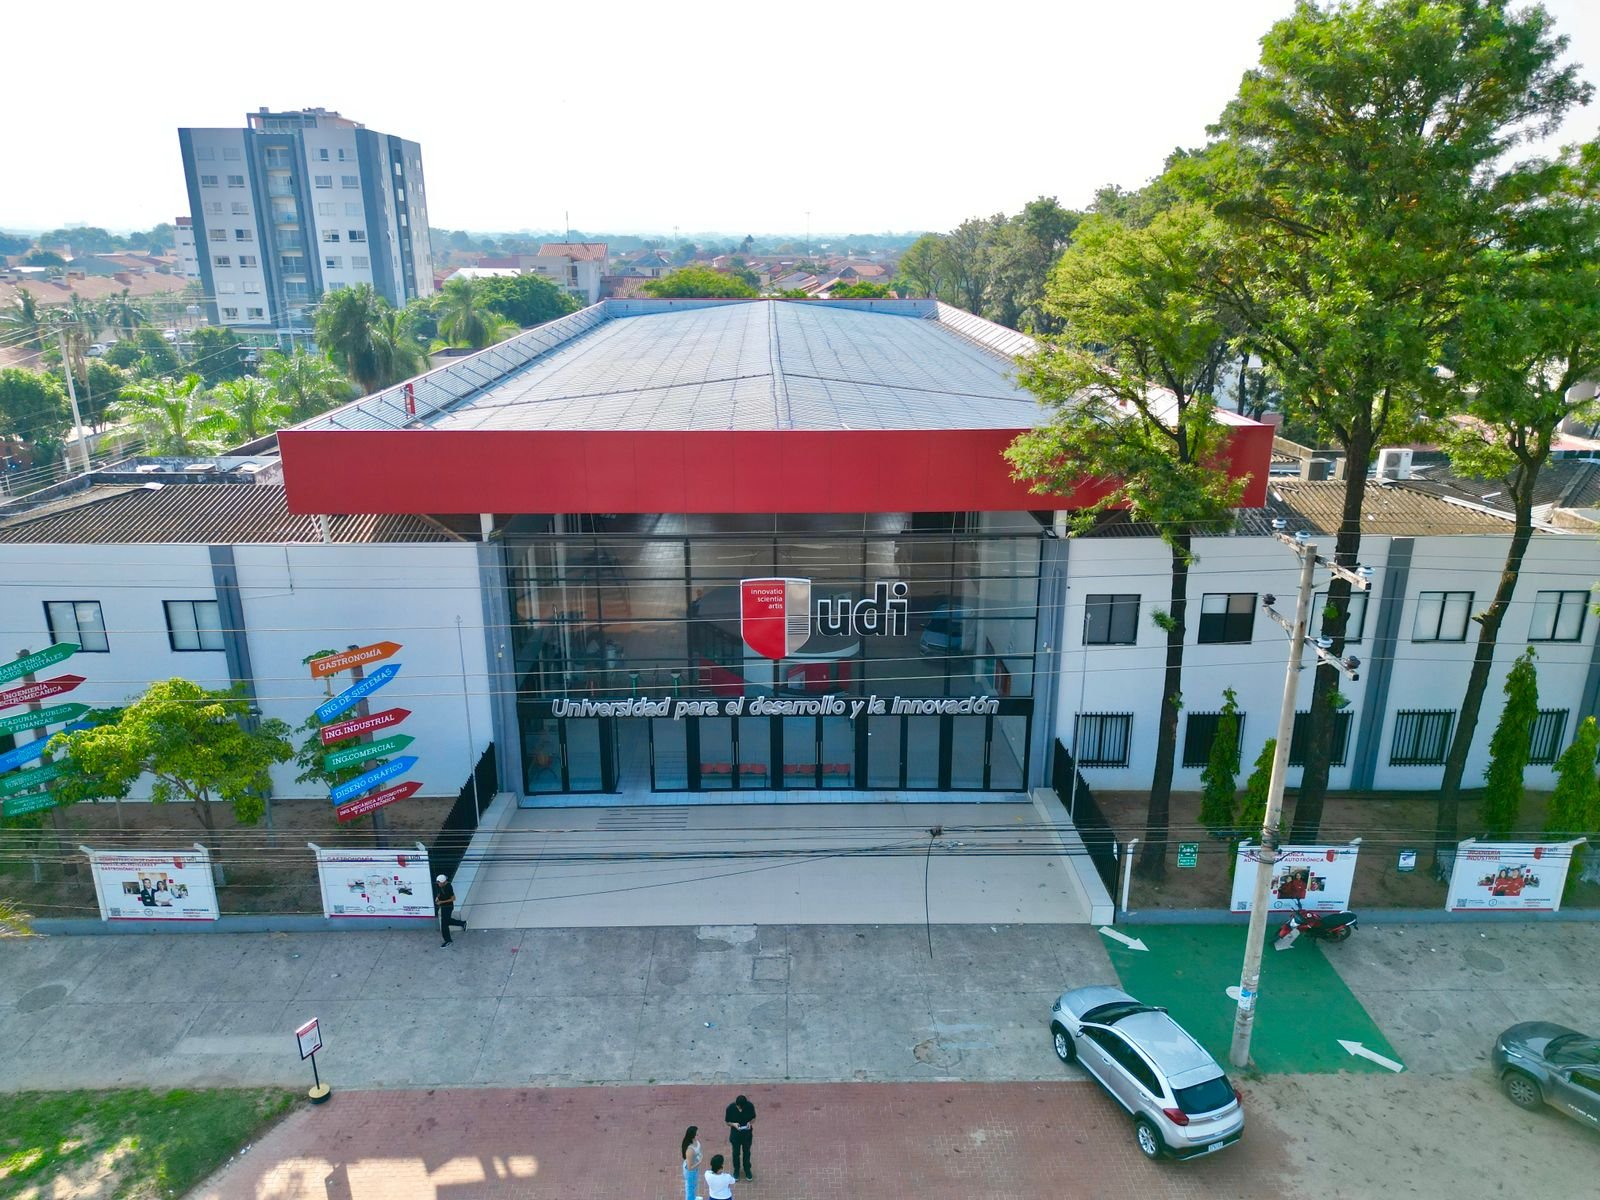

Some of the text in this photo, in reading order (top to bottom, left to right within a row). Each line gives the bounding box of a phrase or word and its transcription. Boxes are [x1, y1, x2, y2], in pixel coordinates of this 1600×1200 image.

[817, 581, 908, 636] udi
[26, 652, 64, 671] DIGITALES
[319, 648, 382, 671] GASTRONOMÍA
[3, 684, 48, 700] INGENIERÍA
[338, 695, 352, 706] DE
[351, 668, 392, 697] SISTEMAS
[551, 697, 671, 718] Universidad
[673, 701, 719, 721] para
[724, 696, 745, 716] el
[749, 695, 846, 716] desarrollo
[850, 700, 865, 719] y
[867, 695, 886, 715] la
[16, 717, 54, 731] FINANZAS
[325, 728, 344, 740] ING.
[344, 714, 396, 734] INDUSTRIAL
